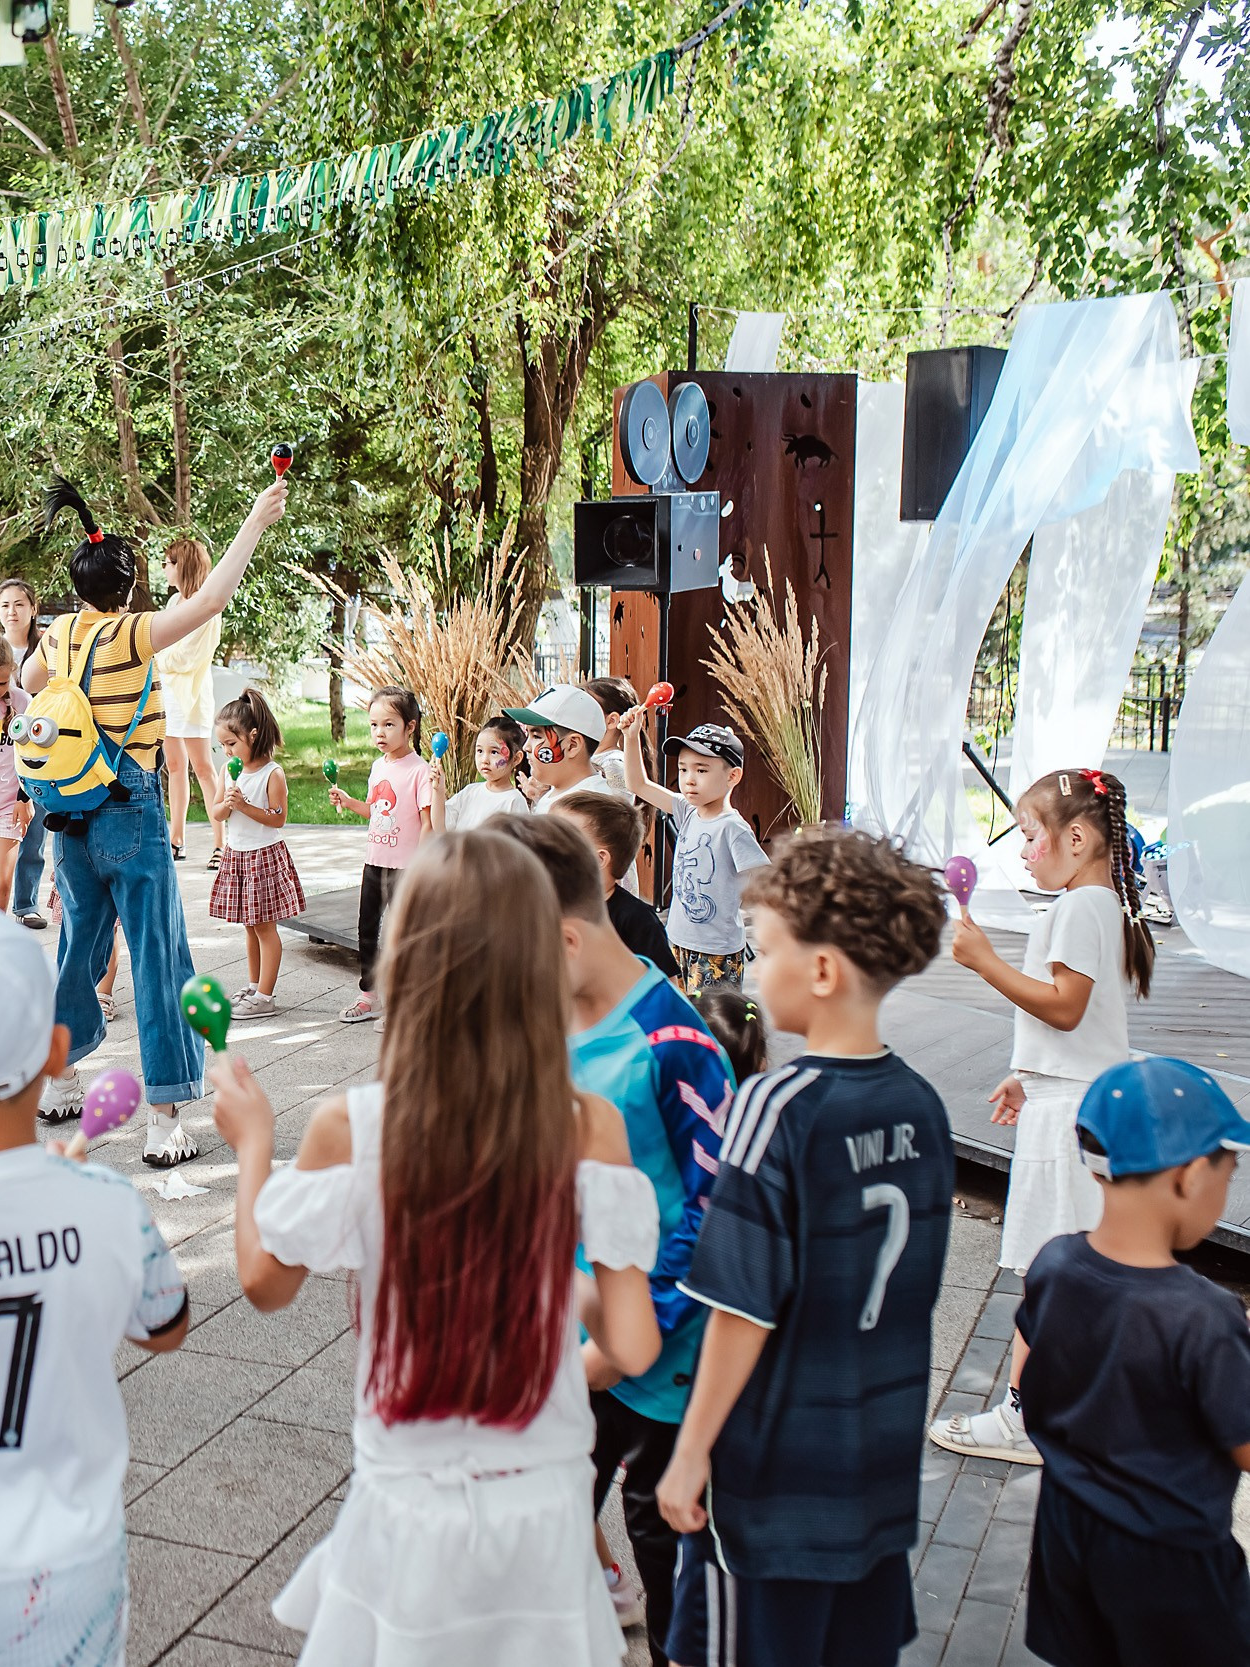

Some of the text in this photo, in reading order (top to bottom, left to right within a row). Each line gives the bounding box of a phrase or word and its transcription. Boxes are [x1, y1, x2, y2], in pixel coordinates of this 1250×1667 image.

[844, 1122, 921, 1174] VINI JR.
[857, 1182, 910, 1331] 7
